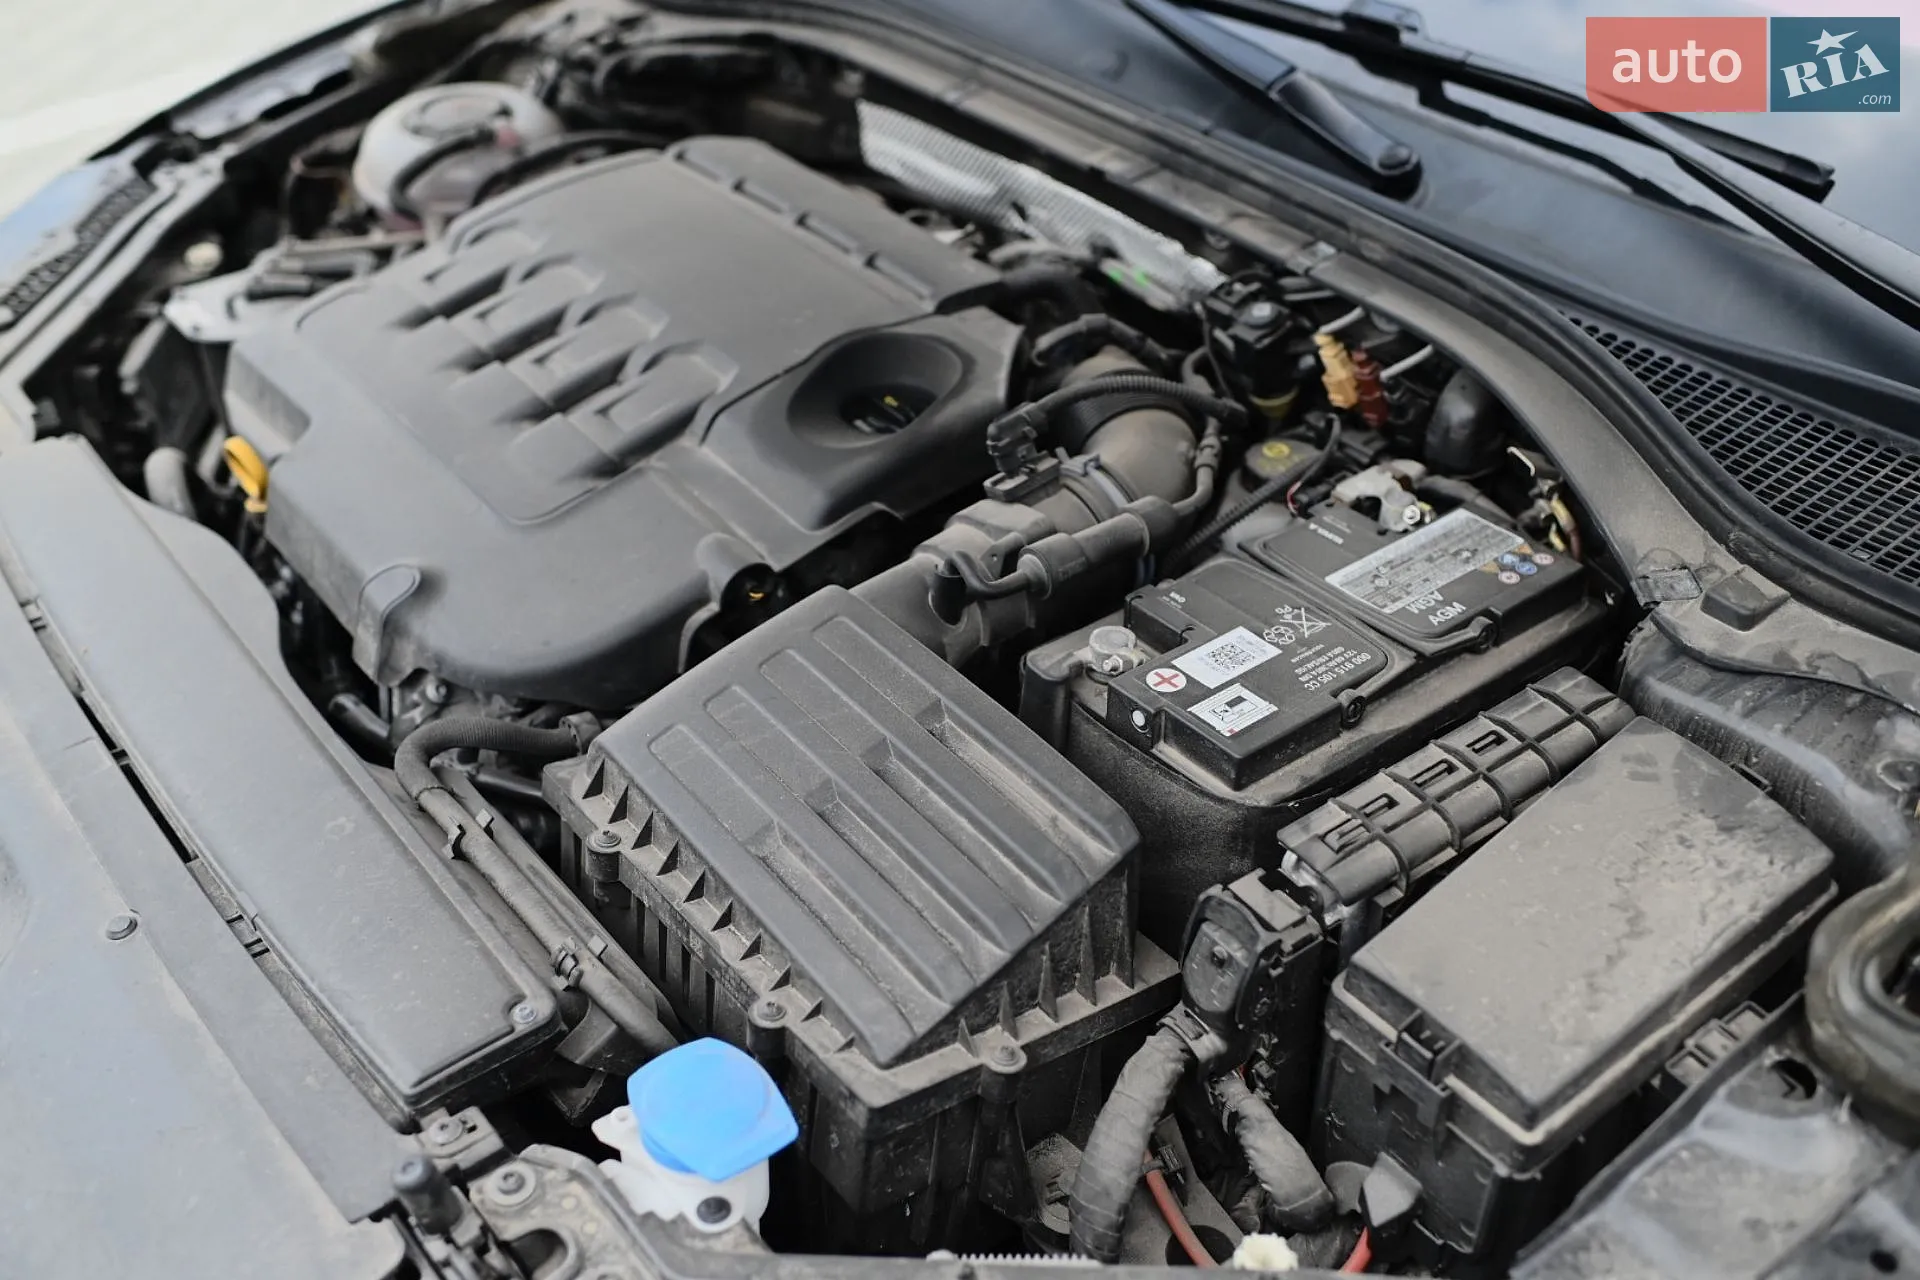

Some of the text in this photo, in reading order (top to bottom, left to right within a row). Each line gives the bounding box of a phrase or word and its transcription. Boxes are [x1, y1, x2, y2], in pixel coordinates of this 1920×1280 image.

[1405, 589, 1444, 614] AGM
[1428, 601, 1467, 626] AGM
[1334, 661, 1355, 674] 915
